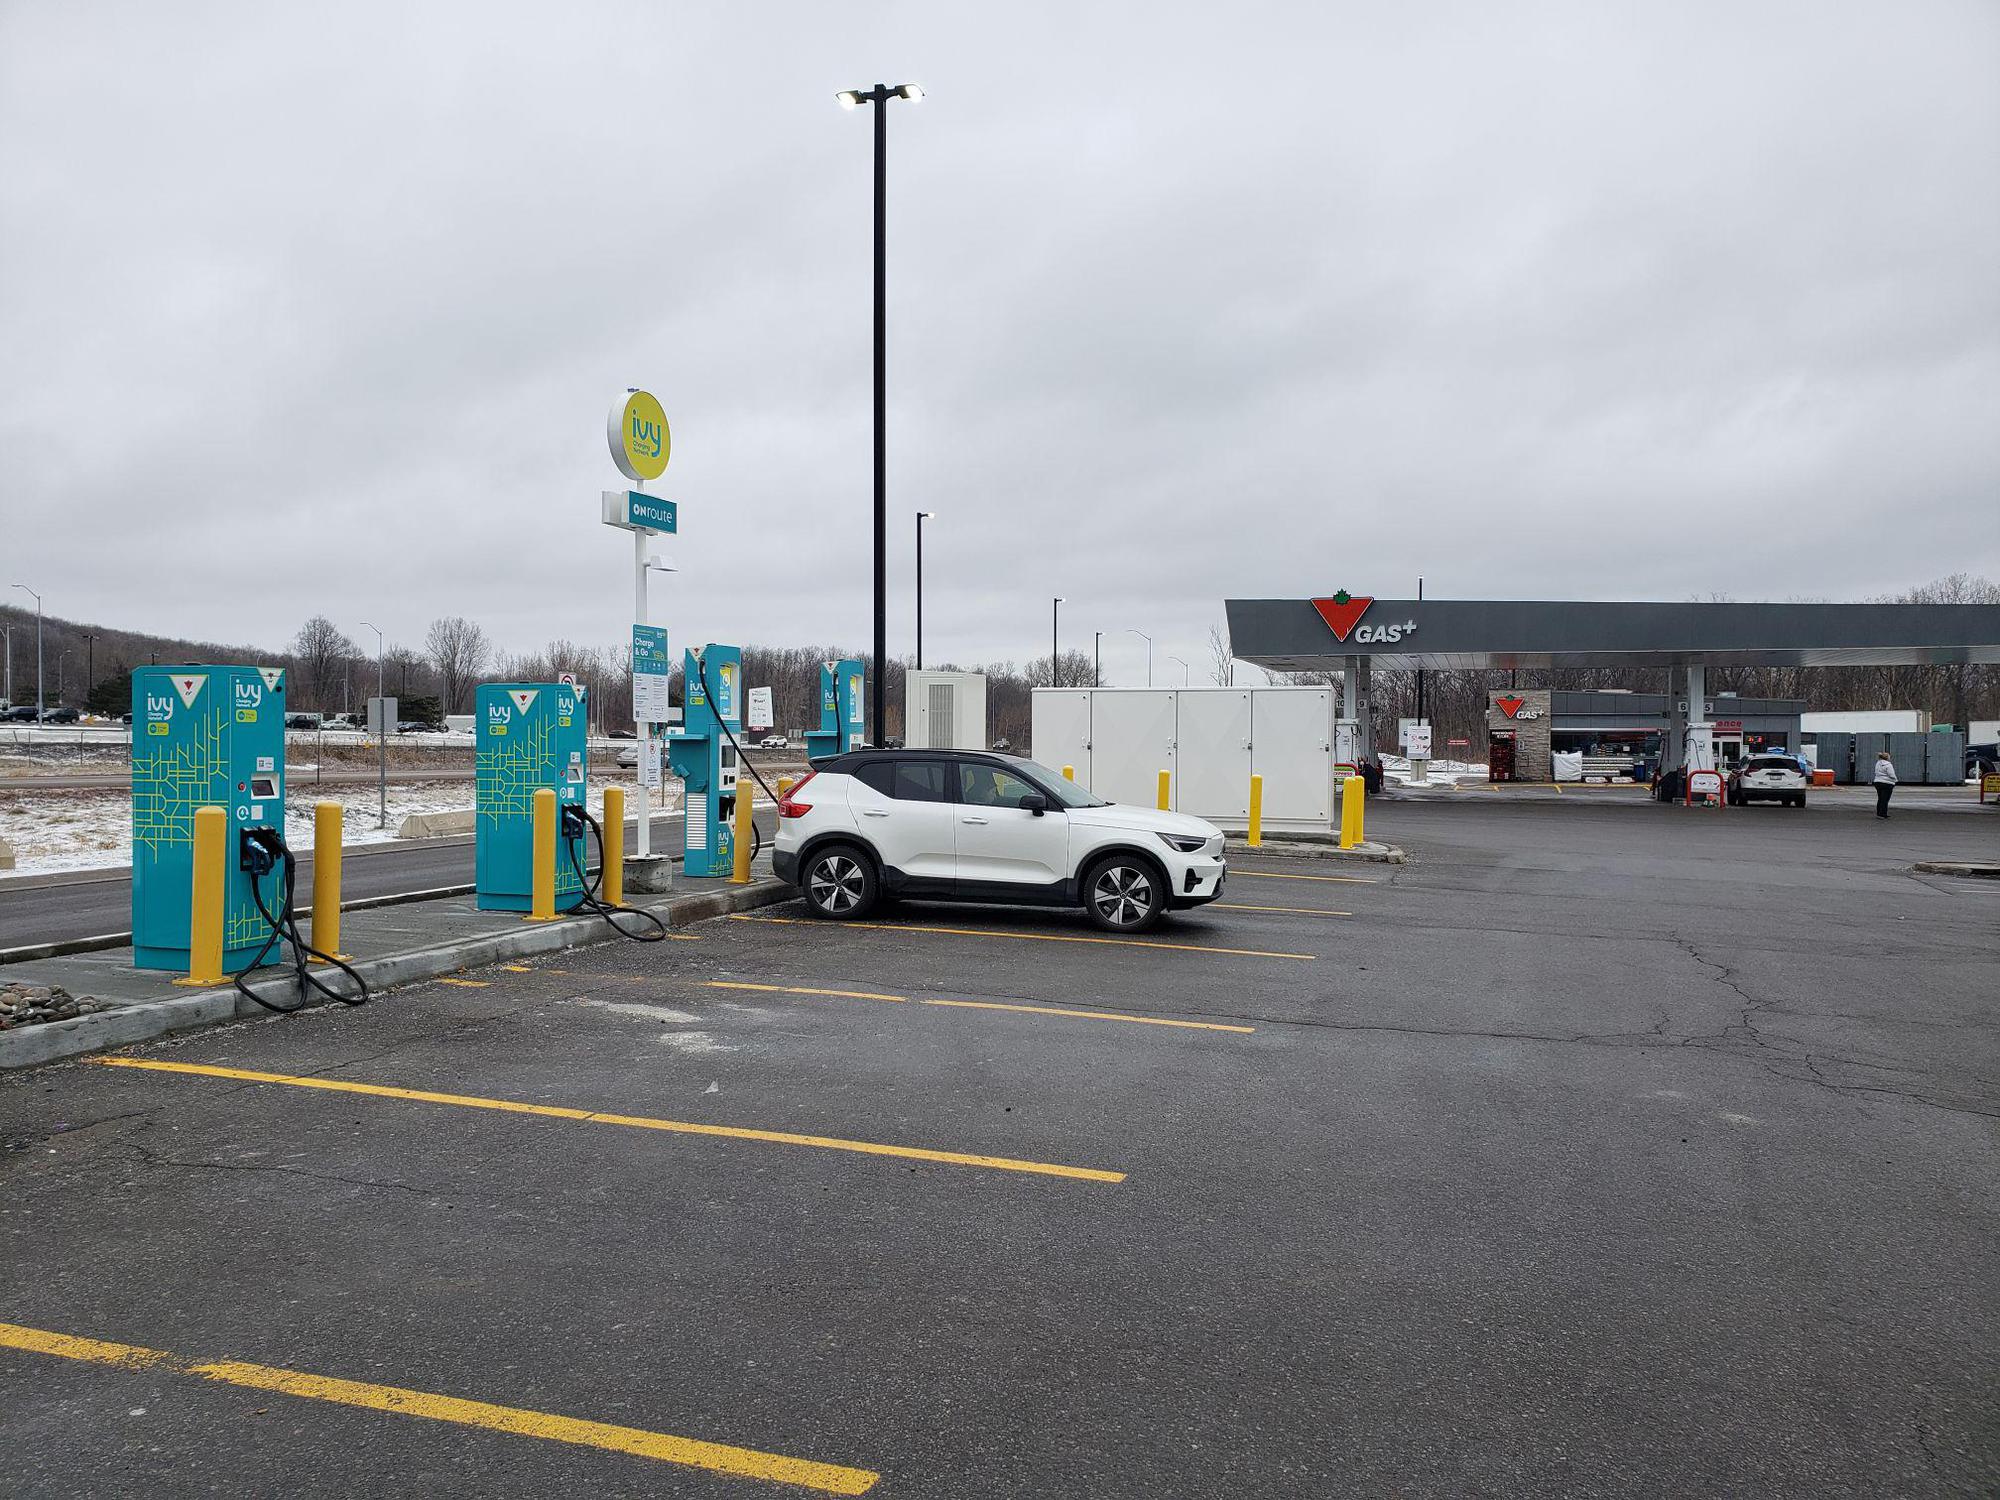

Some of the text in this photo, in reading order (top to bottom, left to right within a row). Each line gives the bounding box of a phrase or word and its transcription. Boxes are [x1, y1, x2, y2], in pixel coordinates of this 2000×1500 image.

[632, 409, 661, 458] ivy
[633, 503, 673, 524] ONroute
[635, 637, 655, 649] Charge
[236, 679, 262, 707] ivy
[147, 692, 174, 721] ivy
[489, 702, 511, 725] ivy
[558, 694, 574, 716] ivy
[1337, 700, 1345, 708] 10
[1680, 702, 1687, 711] 6
[1704, 703, 1711, 712] 5
